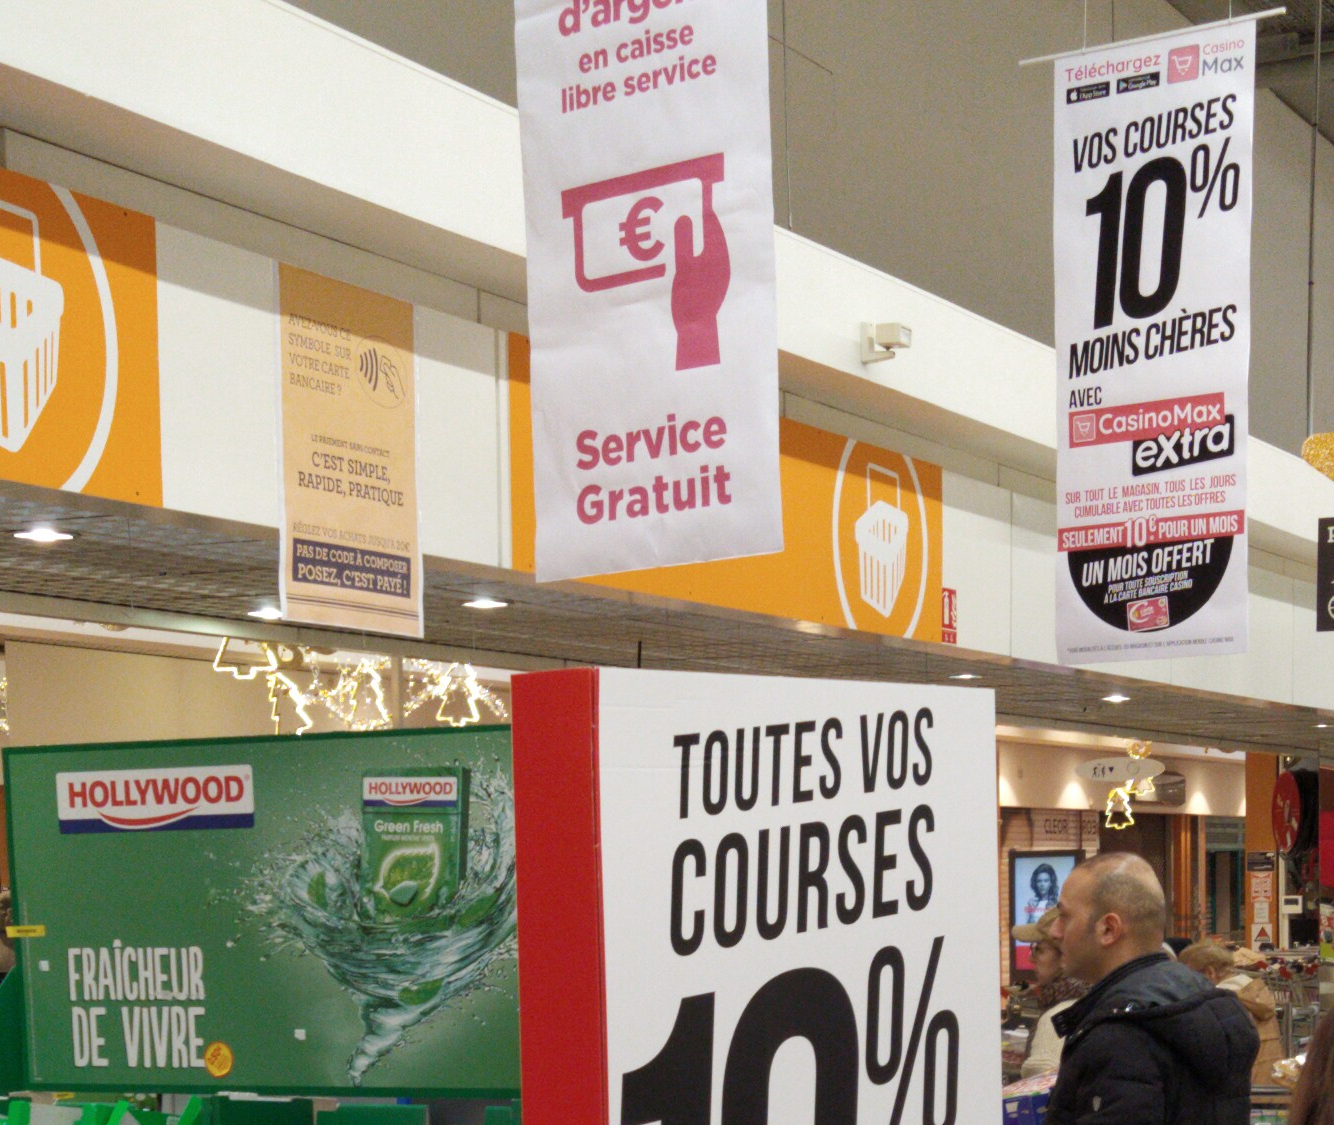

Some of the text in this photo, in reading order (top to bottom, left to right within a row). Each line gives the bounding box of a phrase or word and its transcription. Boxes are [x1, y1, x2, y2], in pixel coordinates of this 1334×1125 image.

[559, 0, 682, 36] d'arg
[579, 25, 693, 73] en caisse
[1066, 39, 1245, 82] Téléchargez Casino
[1202, 54, 1244, 76] Max
[562, 54, 716, 113] libre service
[1073, 93, 1237, 173] VOS COURSES
[1085, 137, 1241, 329] 10%
[288, 333, 351, 361] SYMBOLE SUR
[1069, 304, 1237, 380] MOINS CHÈRES
[289, 352, 350, 380] VOTRE CARTE
[289, 373, 335, 396] BANCAIRE
[1069, 386, 1102, 409] AVEC
[1099, 403, 1221, 434] CasinoMax
[575, 414, 728, 471] Service
[311, 452, 390, 484] C'EST SIMPLE,
[298, 471, 404, 507] RAPIDE, PRATIQUE
[576, 464, 732, 525] Gratuit
[1065, 475, 1236, 504] SUR TOUT LE MAGASIN, TOUS LES JOURS
[1074, 491, 1225, 519] CUMULABLE AVEC TOUTES LES OFFRES
[1062, 525, 1123, 549] SEULEMENT
[1159, 517, 1188, 539] POUR
[1191, 519, 1207, 537] UN
[1209, 515, 1239, 533] MOIS
[296, 544, 314, 560] PAS
[316, 548, 328, 562] DE
[329, 549, 354, 566] CODE
[364, 555, 408, 574] COMPOSER
[1082, 539, 1215, 587] UN MOIS OFFERT
[297, 562, 402, 593] POSEZ, C'EST PAYÉ
[673, 707, 934, 819] TOUTES VOS
[68, 774, 244, 809] HOLLYWOOD
[369, 782, 453, 795] HOLLYWOOD
[374, 820, 443, 833] Green Fresh
[669, 804, 936, 957] COURSES
[68, 939, 205, 1002] FRAÎCHEUR
[72, 1006, 206, 1070] DE VIVRE
